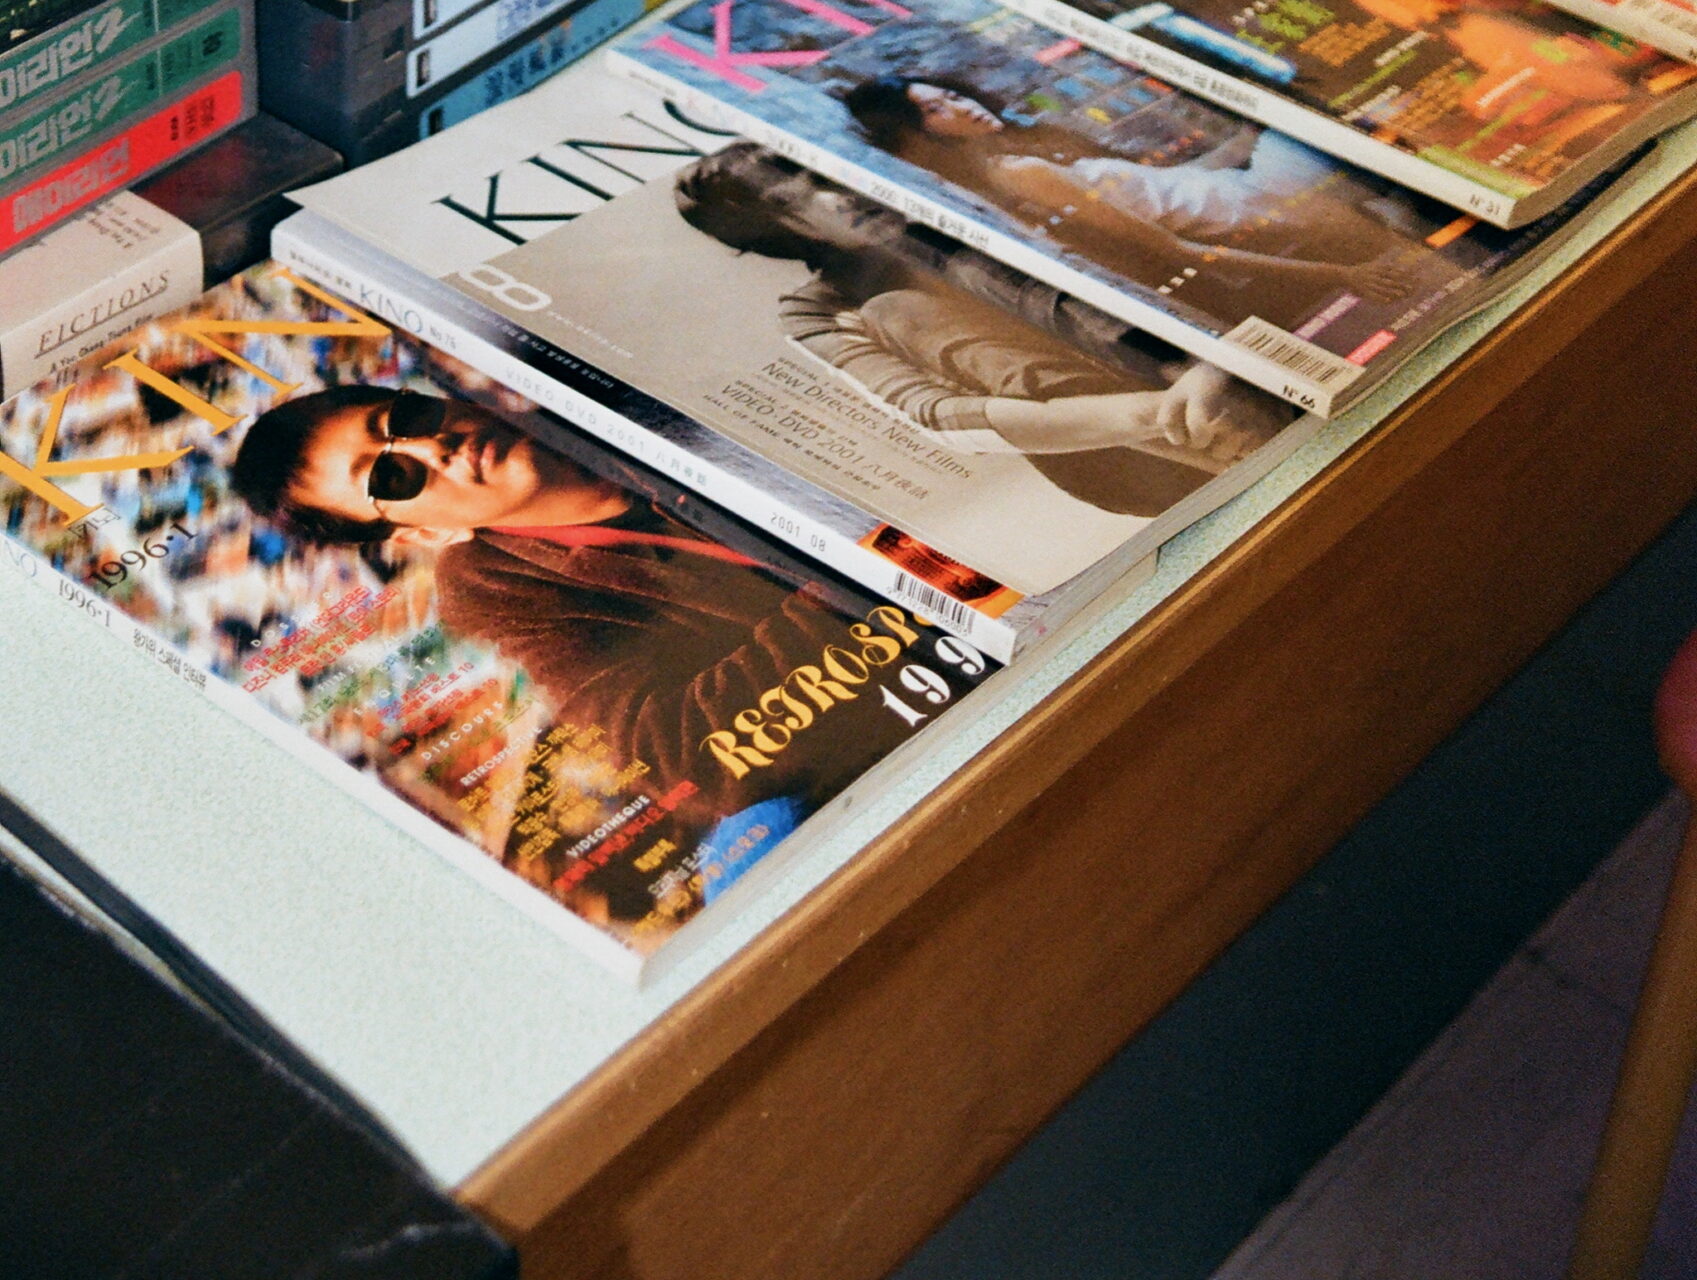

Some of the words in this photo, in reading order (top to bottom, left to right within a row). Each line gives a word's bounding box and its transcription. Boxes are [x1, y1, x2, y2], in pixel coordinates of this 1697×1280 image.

[36, 270, 170, 355] FICTIONS
[359, 283, 424, 334] KINO
[761, 361, 806, 389] New
[803, 383, 879, 432] Directors
[882, 423, 927, 453] New
[926, 449, 973, 480] Films
[1299, 393, 1317, 410] 66
[505, 367, 555, 402] VIDEO
[563, 400, 598, 426] DVD
[770, 512, 801, 539] 2001
[809, 533, 828, 553] 08
[818, 438, 864, 465] 2001
[699, 606, 934, 781] RETROSP
[566, 791, 650, 860] VIDEOTHEQUE
